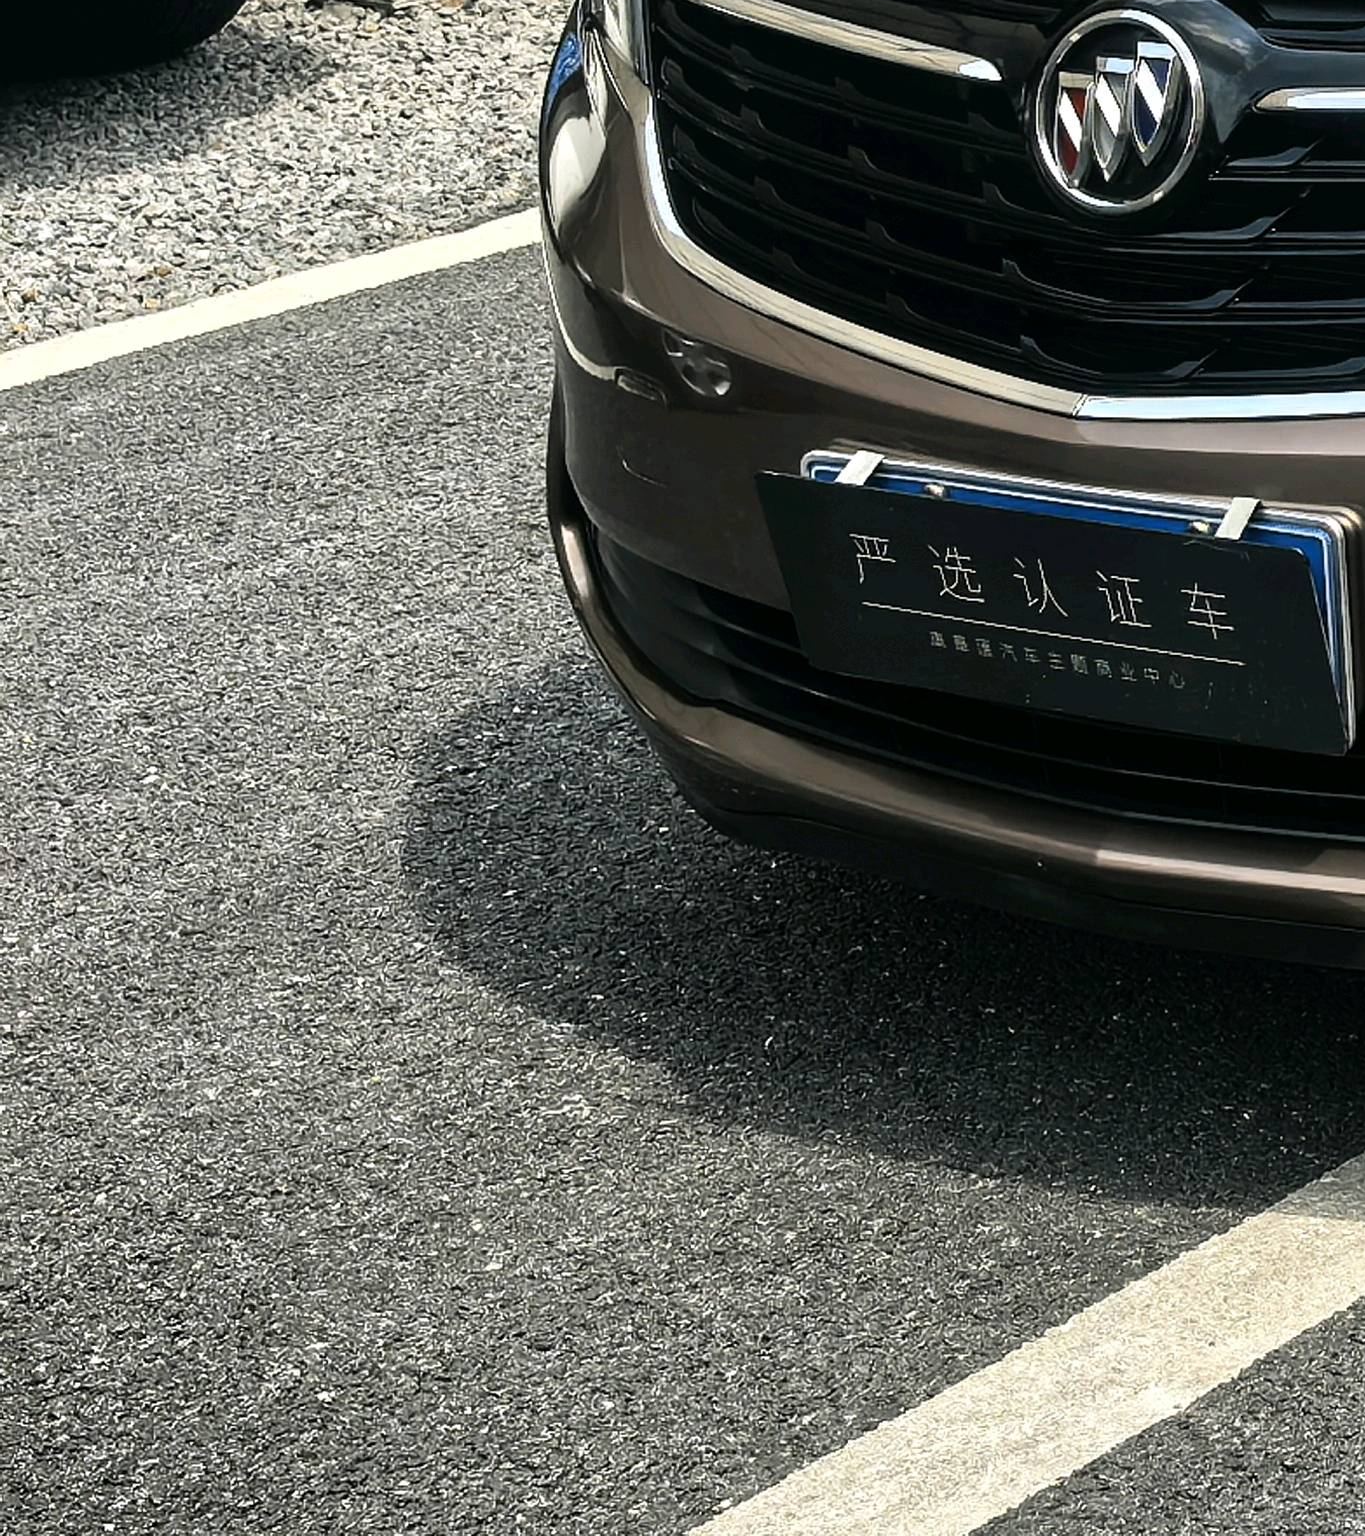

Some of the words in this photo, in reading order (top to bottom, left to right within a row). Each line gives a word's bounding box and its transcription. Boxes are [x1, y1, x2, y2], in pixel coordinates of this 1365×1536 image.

[848, 533, 1234, 639] 严选认证车
